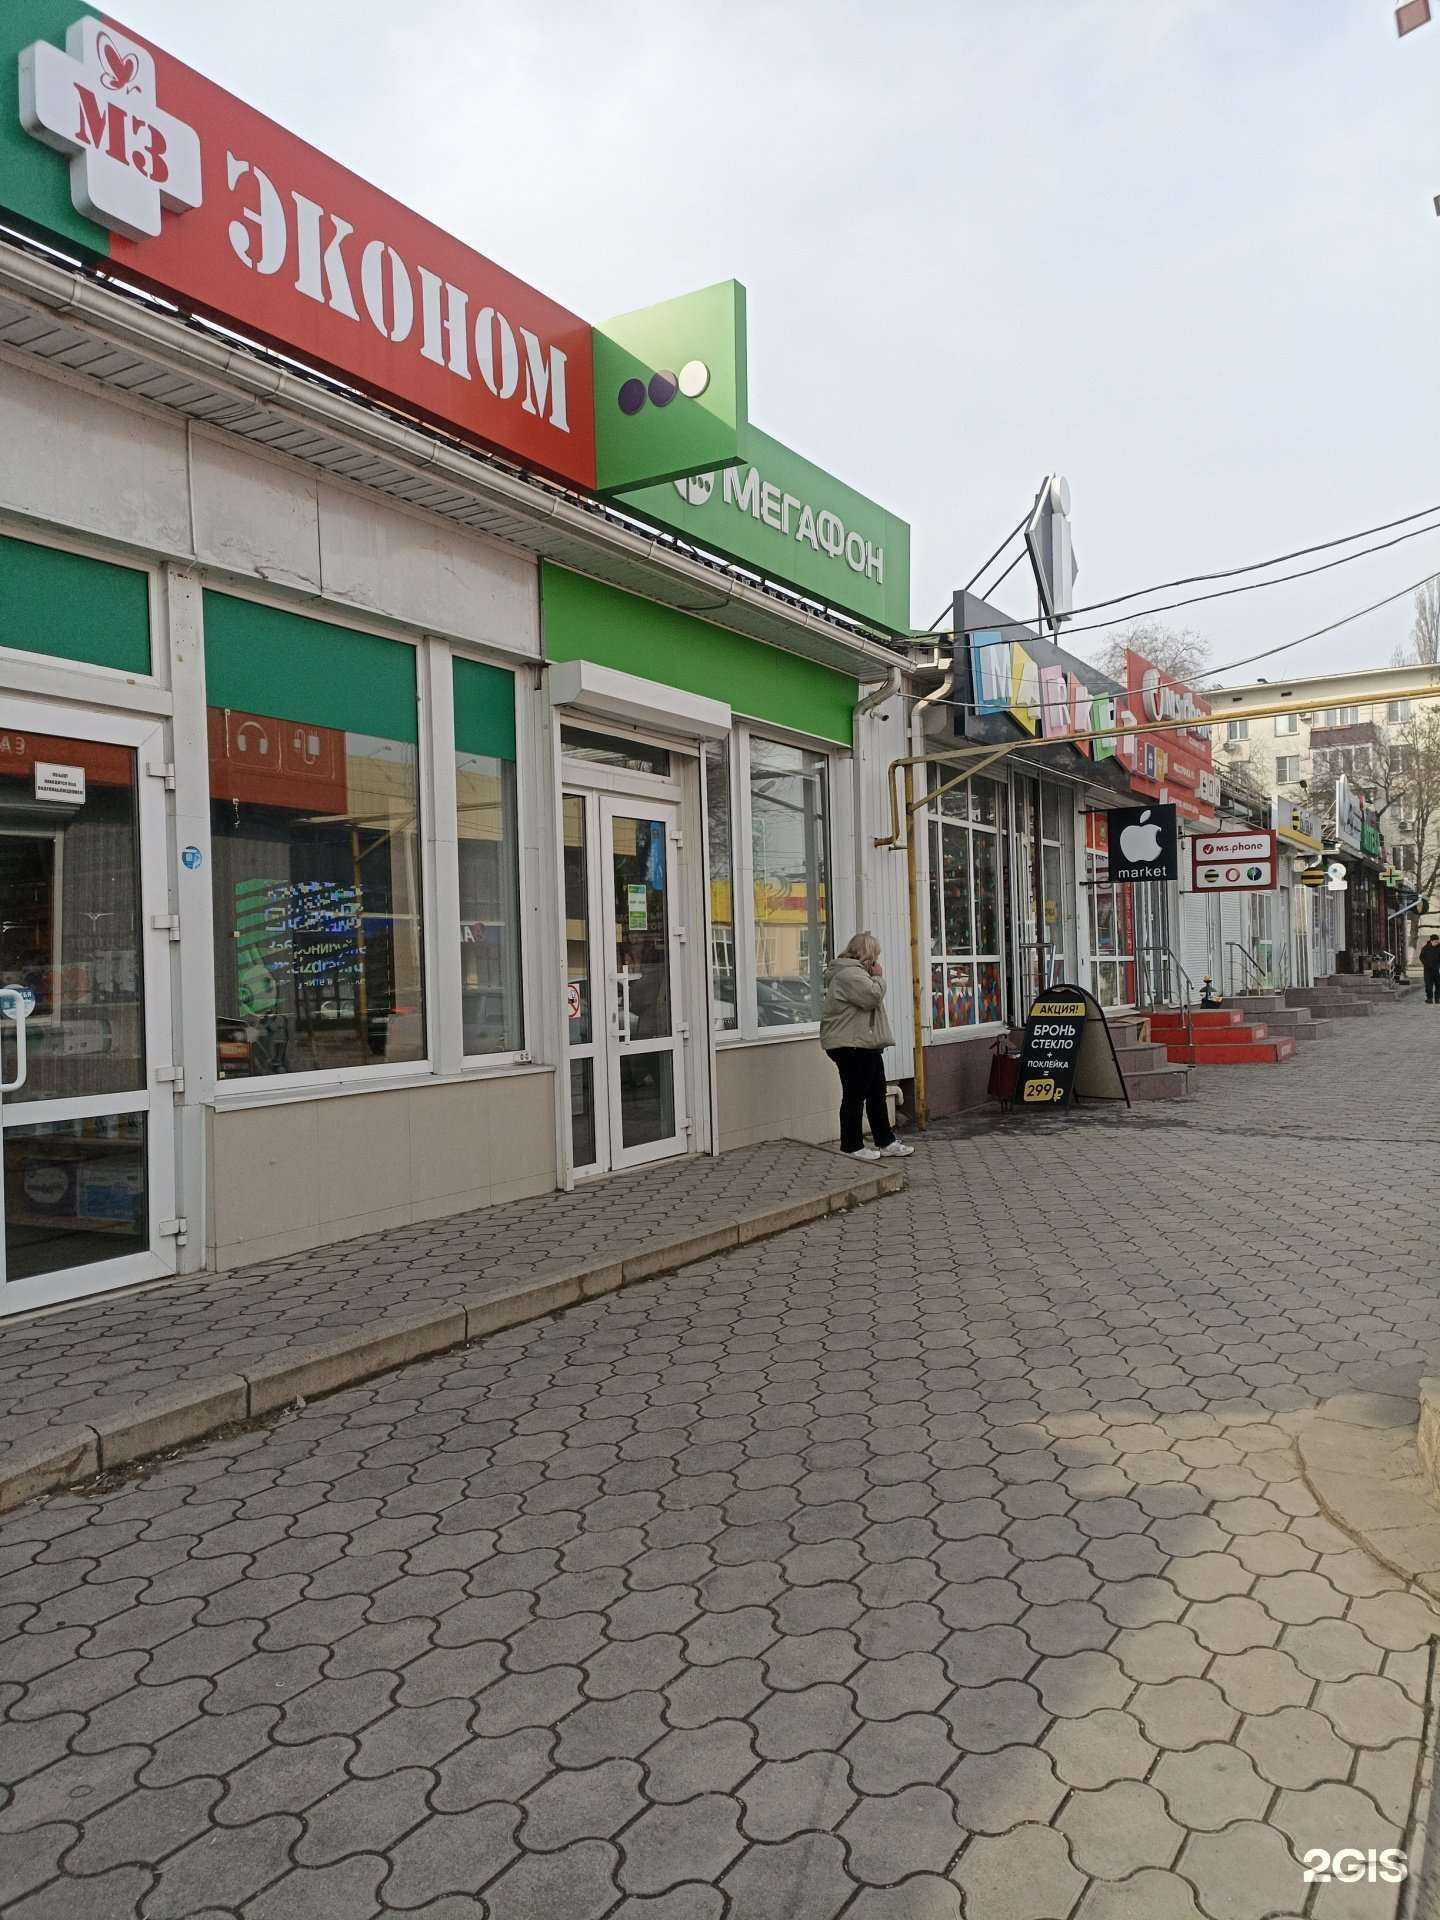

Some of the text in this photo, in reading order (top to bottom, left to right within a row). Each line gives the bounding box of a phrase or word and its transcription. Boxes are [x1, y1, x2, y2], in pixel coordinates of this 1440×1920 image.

[226, 149, 571, 434] ЭКОНОМ
[723, 465, 884, 586] МЕГАФОН
[1118, 865, 1168, 879] market
[1040, 1005, 1080, 1016] АКЦИЯ!
[1033, 1024, 1076, 1036] БРОНЬ
[1031, 1039, 1074, 1049] СТЕКЛО
[1027, 1059, 1069, 1069] ПОКЛЕЙКА
